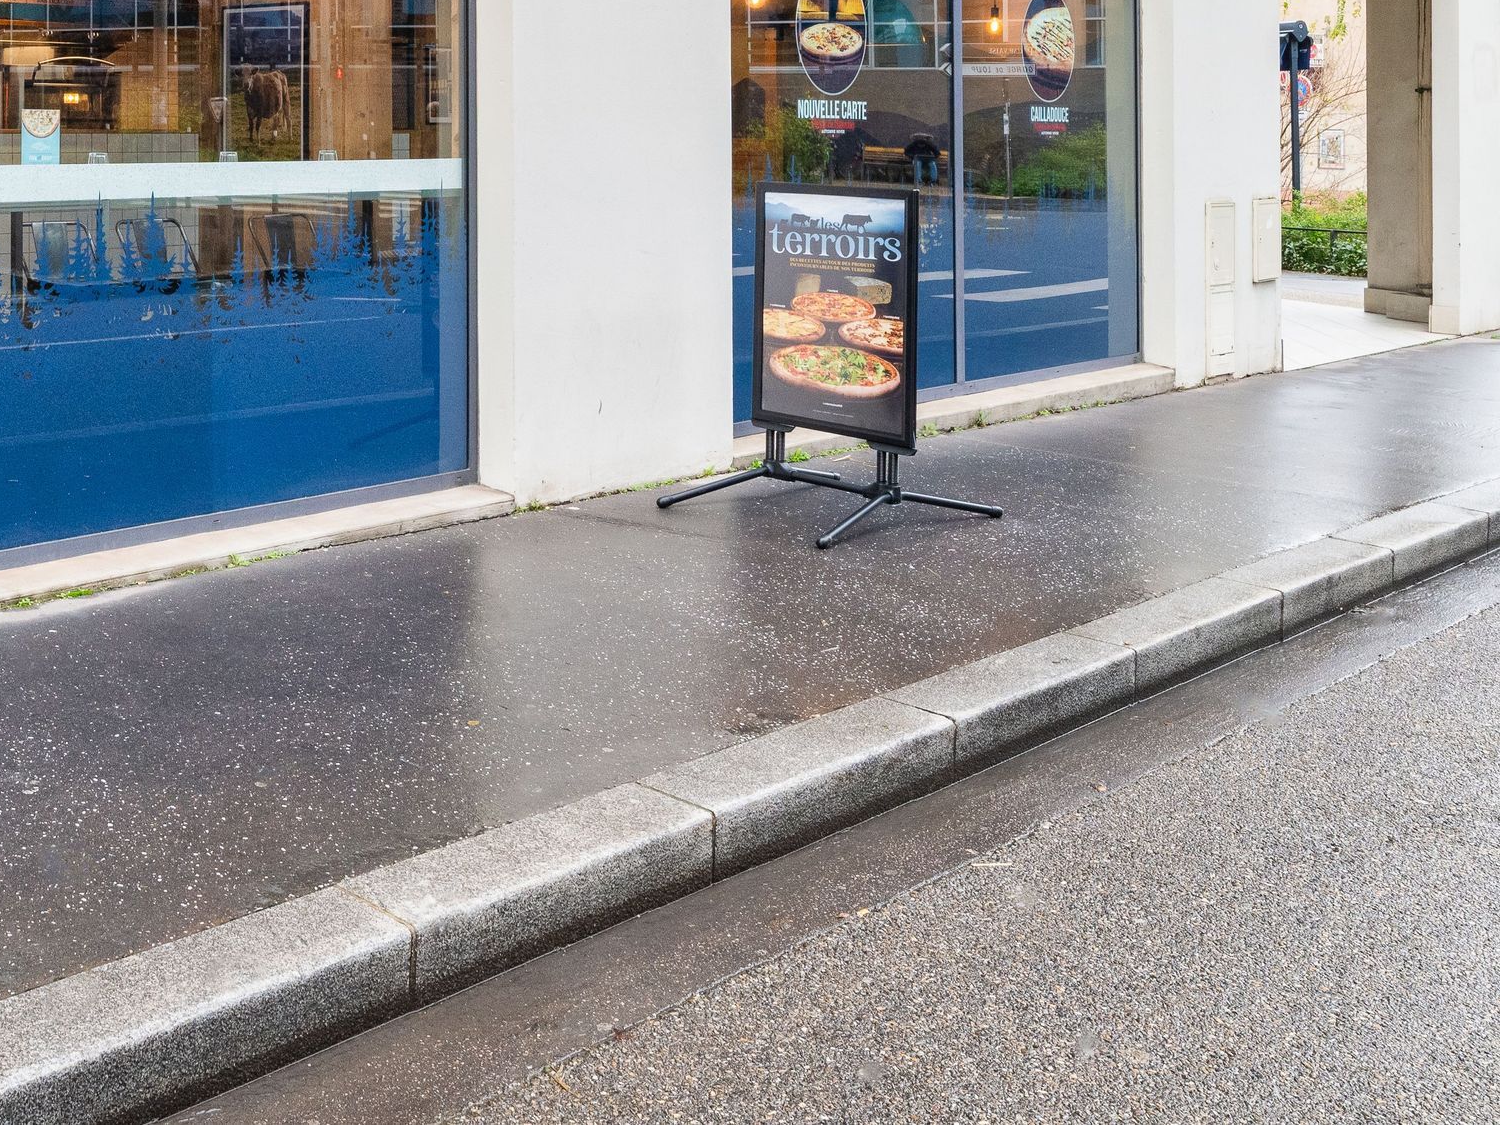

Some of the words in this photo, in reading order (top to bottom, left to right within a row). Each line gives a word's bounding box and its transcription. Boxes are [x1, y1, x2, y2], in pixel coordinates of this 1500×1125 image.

[797, 99, 840, 119] NOUVELLE
[841, 101, 867, 120] CARTE
[1030, 106, 1069, 123] CAILLADOUCE
[821, 217, 841, 231] les
[769, 223, 902, 262] terroirs
